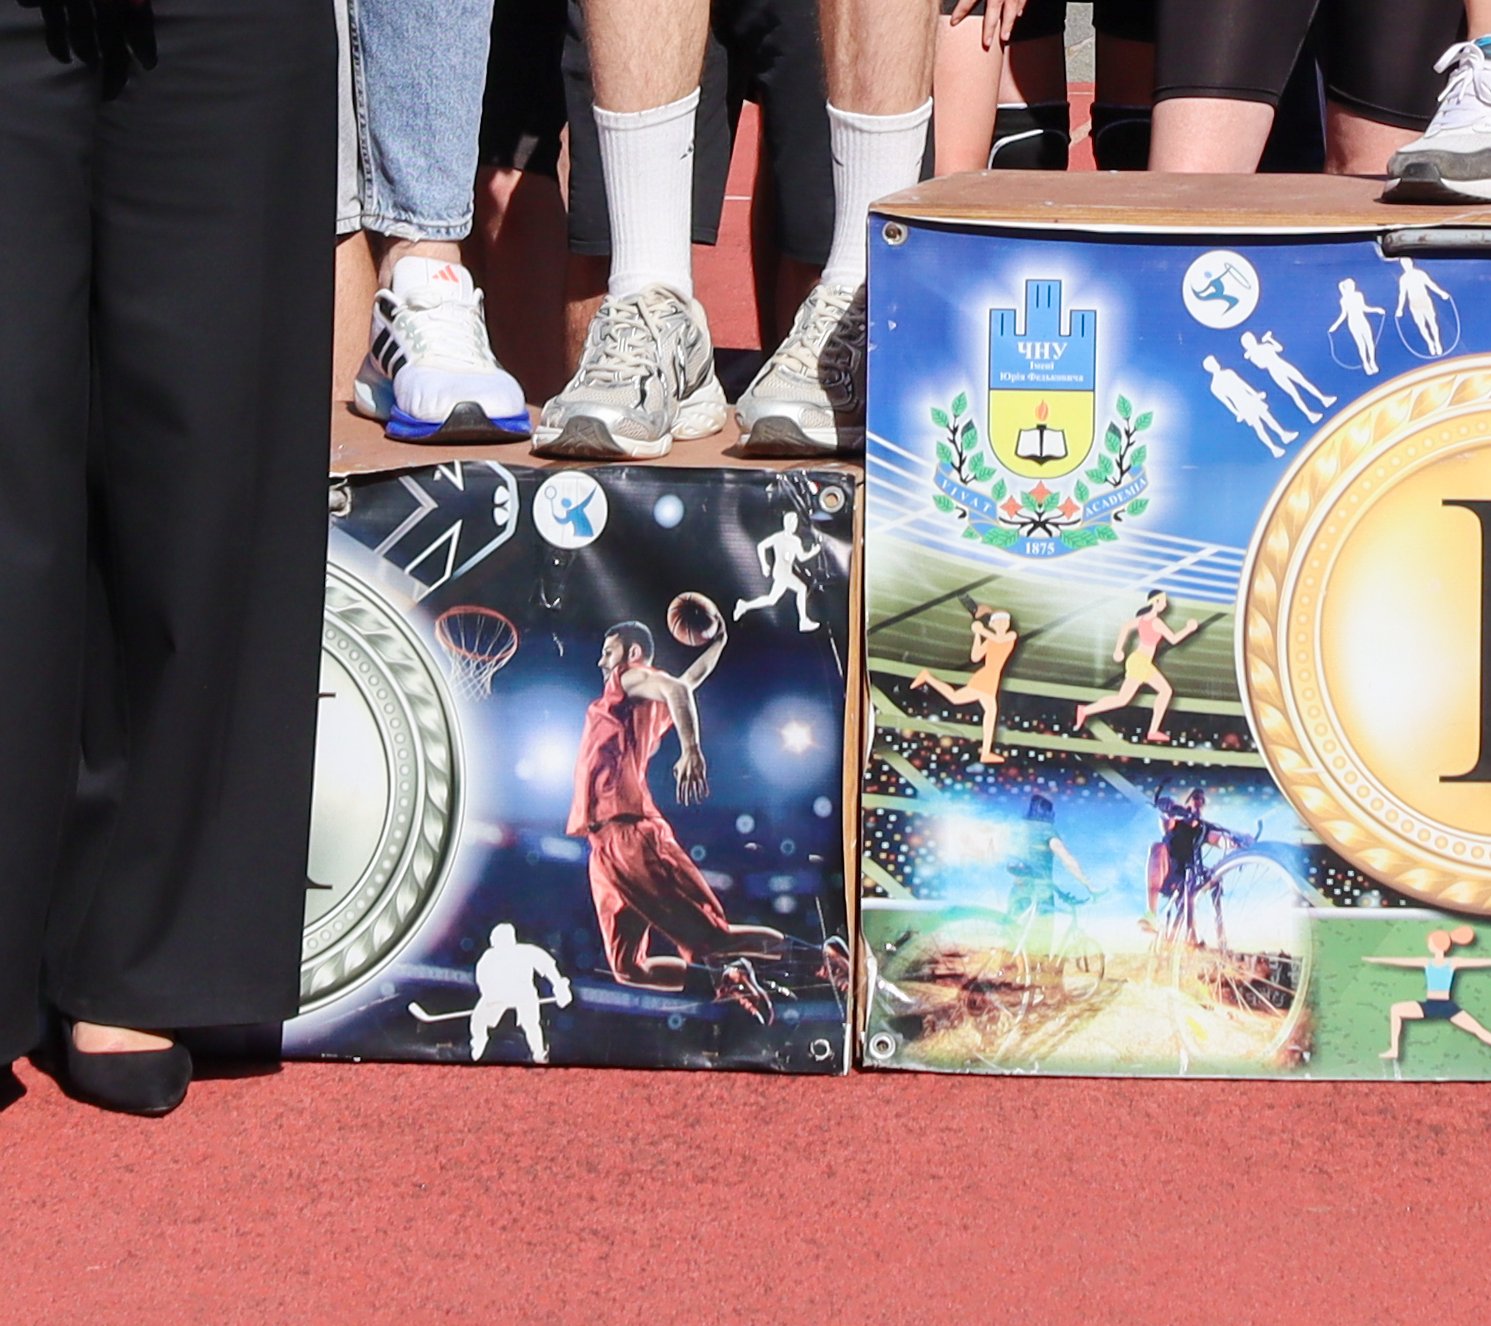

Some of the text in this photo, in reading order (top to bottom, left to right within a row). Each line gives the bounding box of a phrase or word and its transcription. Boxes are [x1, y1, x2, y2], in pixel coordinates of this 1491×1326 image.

[1017, 341, 1069, 360] ЧНУ
[999, 372, 1085, 383] Юрія Федьковича
[940, 479, 993, 513] VIVAT
[1085, 476, 1148, 518] ACADEMIA
[1024, 542, 1056, 555] 1875
